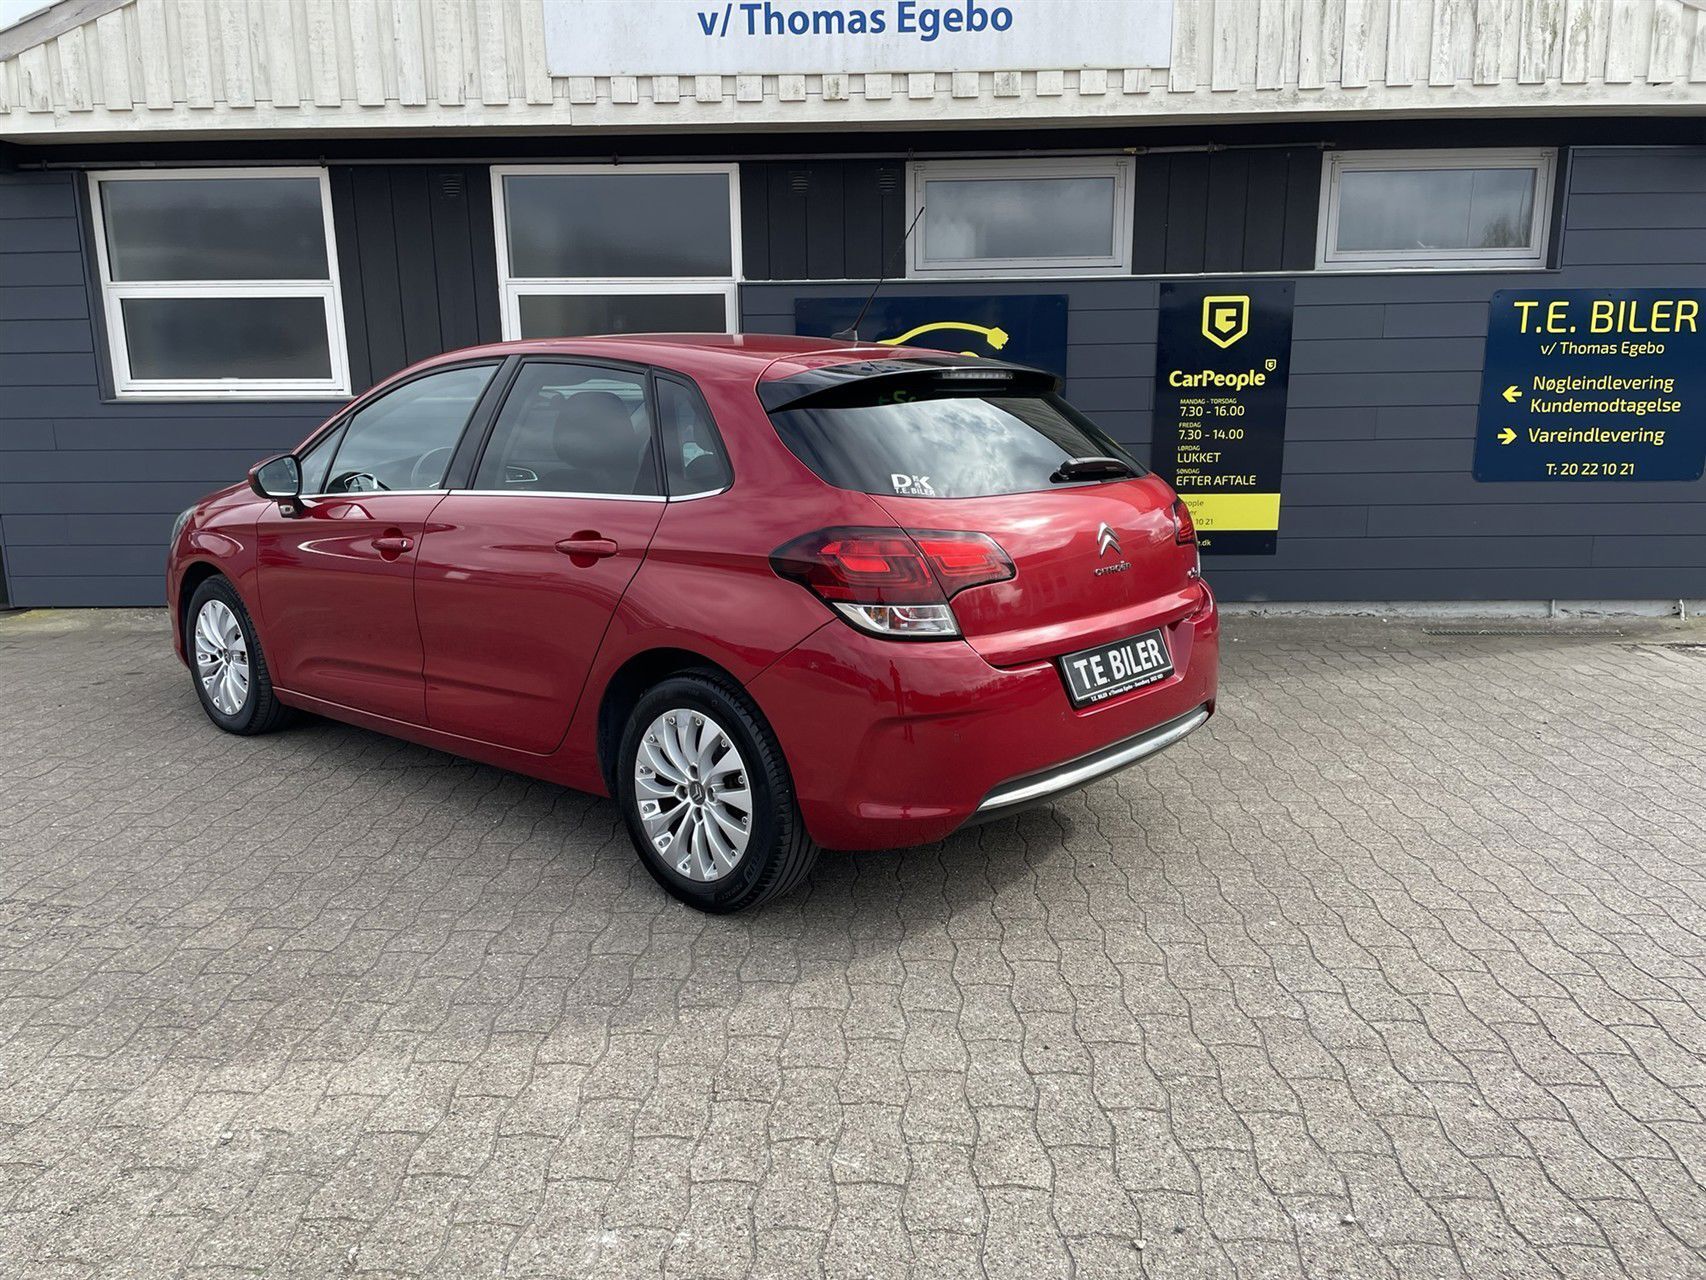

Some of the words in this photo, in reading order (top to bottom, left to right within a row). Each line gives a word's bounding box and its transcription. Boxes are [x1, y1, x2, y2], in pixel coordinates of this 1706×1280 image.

[697, 3, 733, 37] v/
[740, 2, 887, 35] Thomas
[897, 0, 1014, 42] Egebo
[1513, 301, 1577, 334] T.E.
[1590, 300, 1699, 333] BILER
[1540, 342, 1557, 355] v/
[1560, 341, 1618, 355] Thomas
[1621, 341, 1665, 357] Egebo
[1168, 369, 1266, 391] CarPeople
[1533, 375, 1675, 394] Nøgleindlevering
[1180, 406, 1204, 417] 7.30
[1214, 405, 1245, 417] 16.00
[1530, 398, 1682, 416] Kundemodtagelse
[1178, 429, 1202, 440] 7.30
[1213, 429, 1244, 440] 14.00
[1528, 427, 1666, 446] Vareindlevering
[1177, 452, 1222, 463] LUKKET
[1546, 463, 1558, 476] T:
[1560, 463, 1579, 475] 20
[1581, 463, 1599, 475] 22
[1601, 463, 1617, 475] 10
[1619, 463, 1635, 475] 21
[890, 473, 934, 490] DK
[1176, 475, 1212, 486] EFTER
[1213, 475, 1257, 486] AFTALE
[1073, 655, 1110, 690] T.E.
[1108, 638, 1165, 681] BILER
